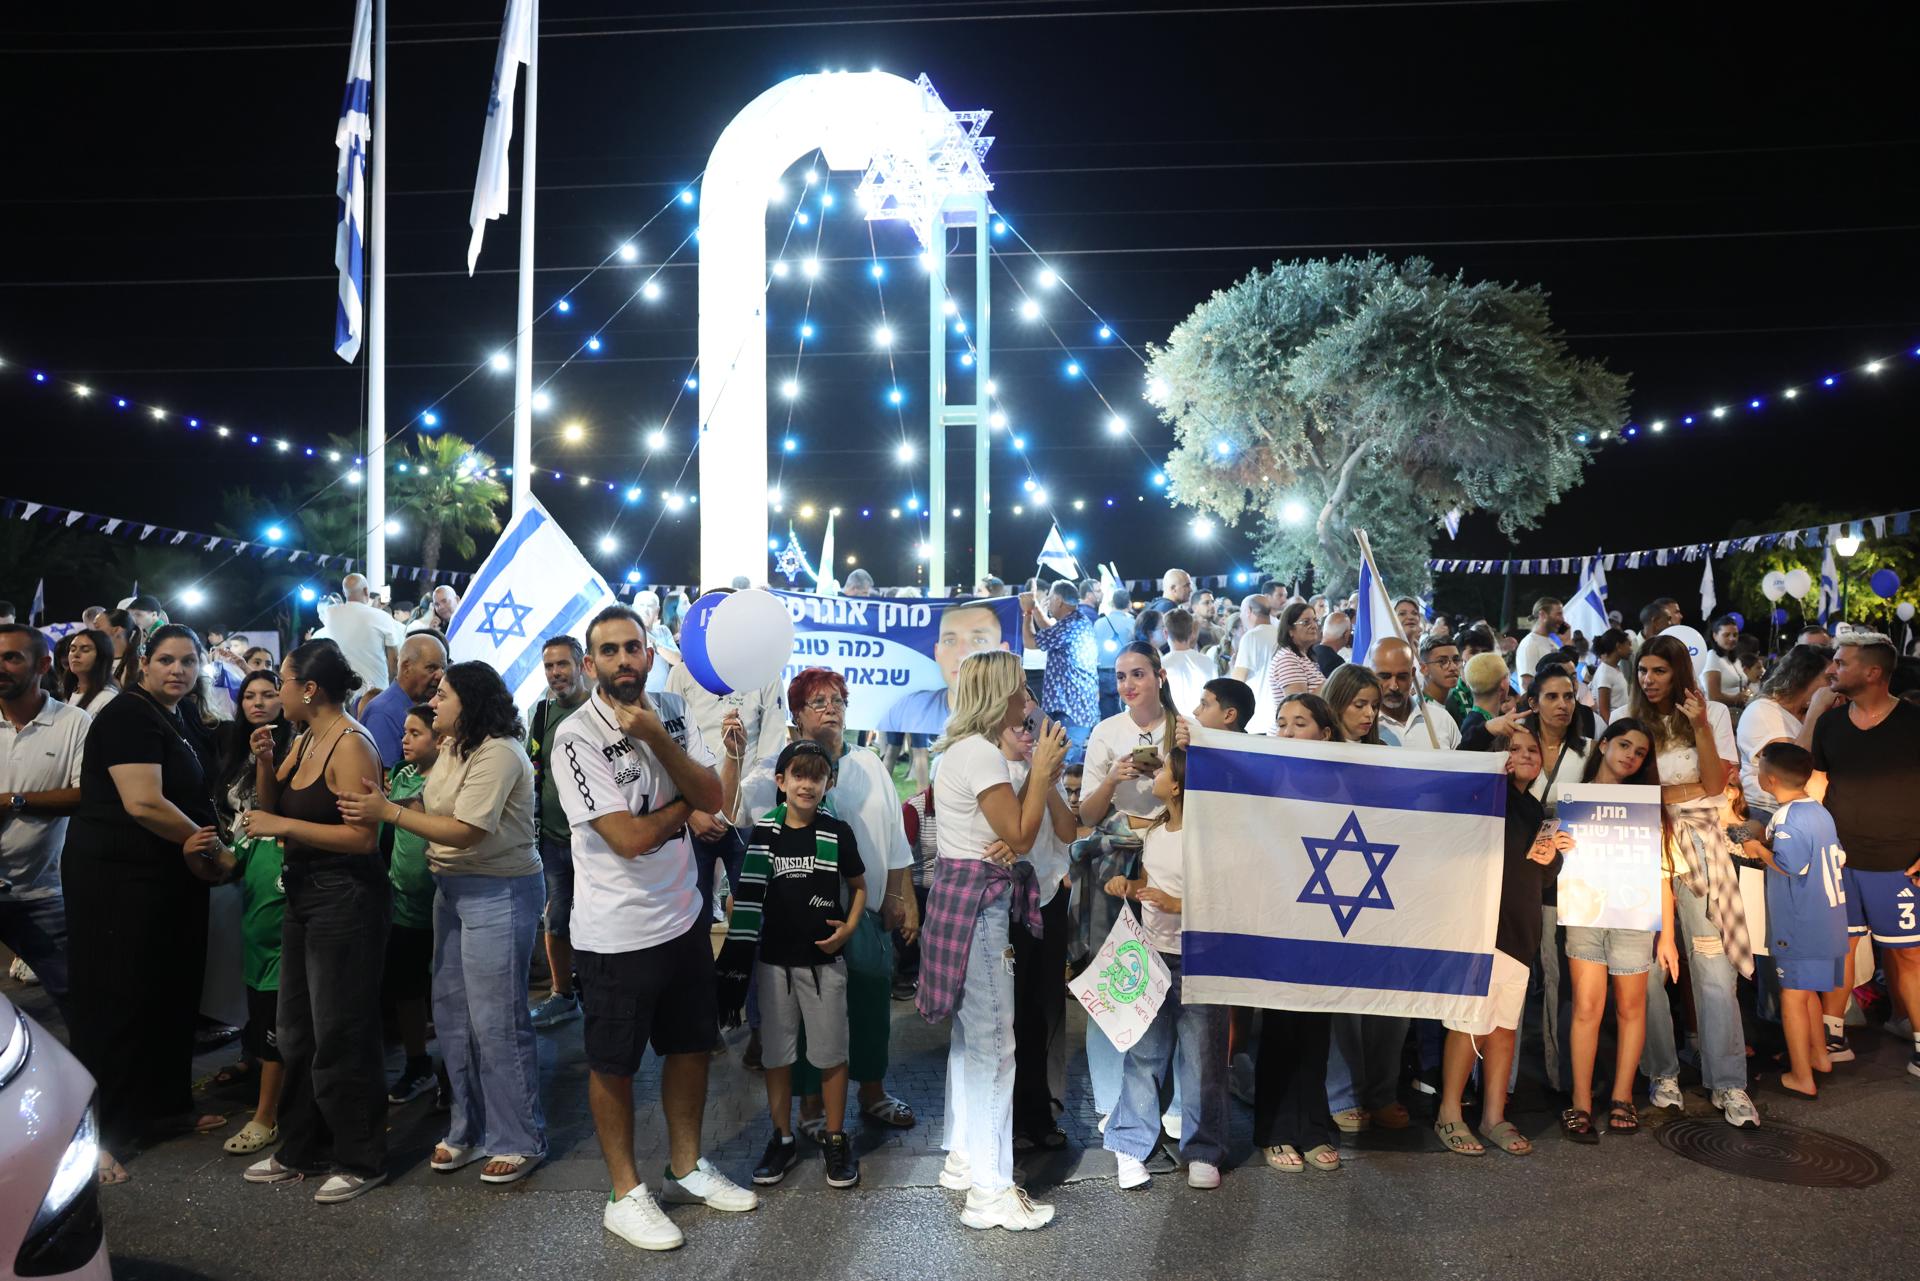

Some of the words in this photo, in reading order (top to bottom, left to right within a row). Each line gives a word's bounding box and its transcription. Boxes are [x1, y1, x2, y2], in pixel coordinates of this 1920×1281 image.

[778, 597, 869, 626] אנגרס
[878, 602, 932, 633] מתן
[838, 639, 885, 658] כמה
[844, 666, 911, 687] שבאת
[1591, 805, 1628, 822] מתן,
[1613, 824, 1651, 841] ברוך
[1898, 903, 1916, 930] 3
